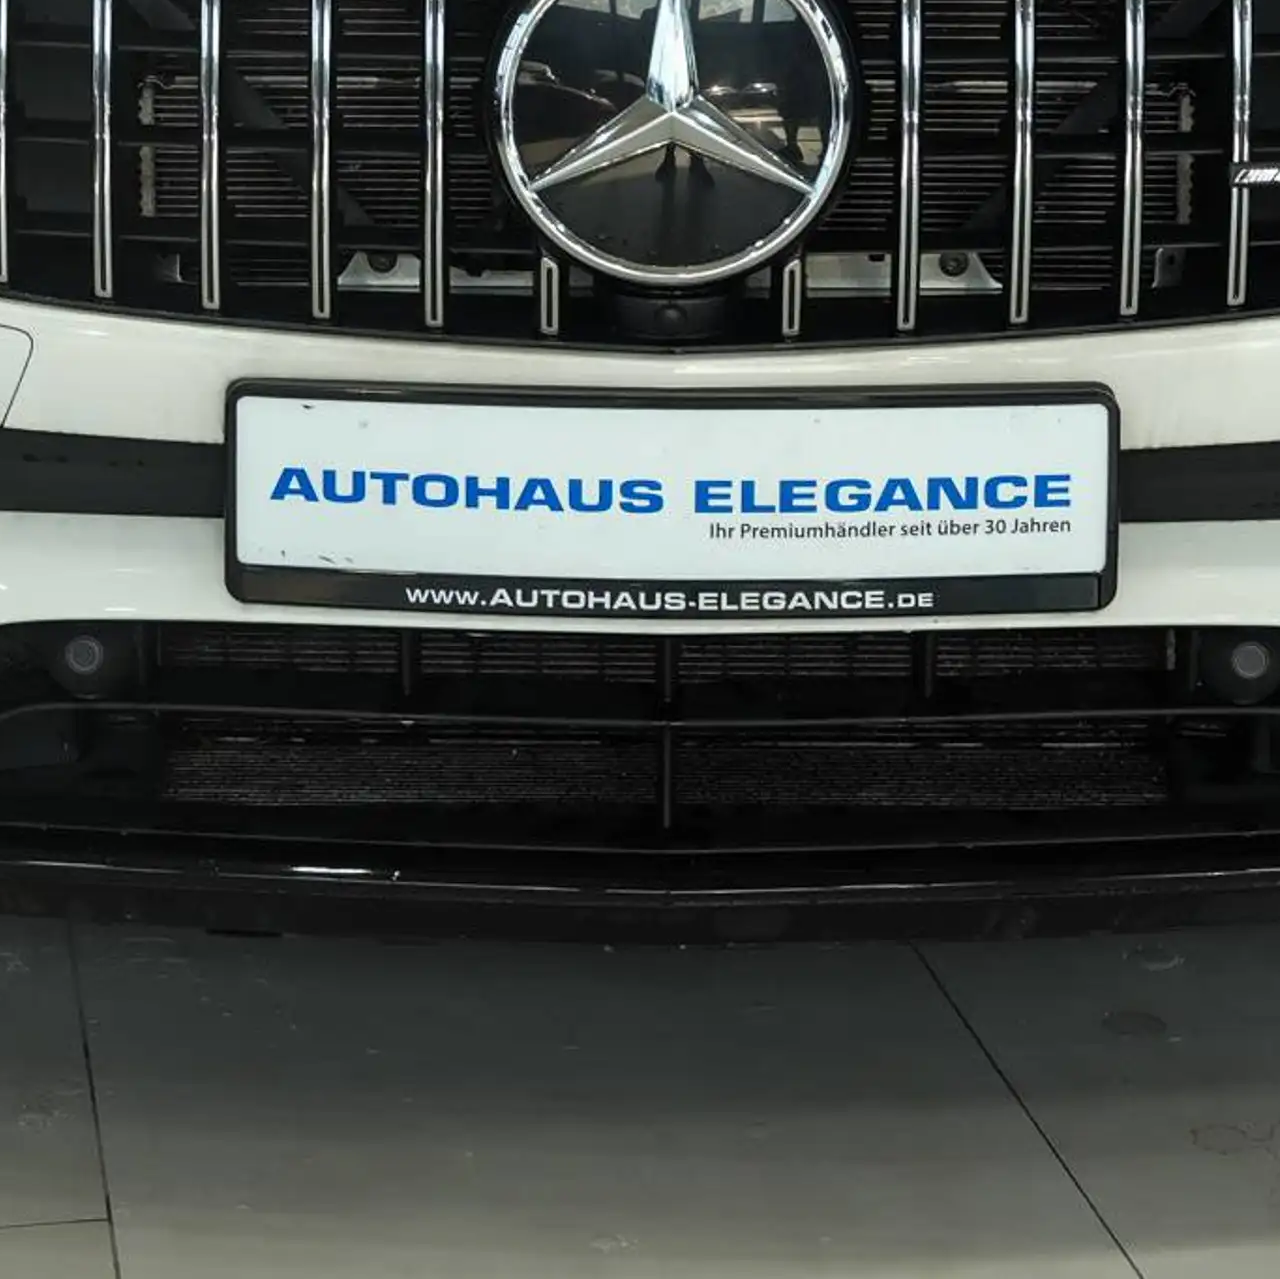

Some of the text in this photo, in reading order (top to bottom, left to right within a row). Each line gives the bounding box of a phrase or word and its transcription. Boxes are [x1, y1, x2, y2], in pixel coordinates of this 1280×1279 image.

[270, 467, 1071, 514] AUTOHAUS ELEGANCE
[710, 516, 1071, 539] Ihr Premiumhändler seit über 30 Jahren
